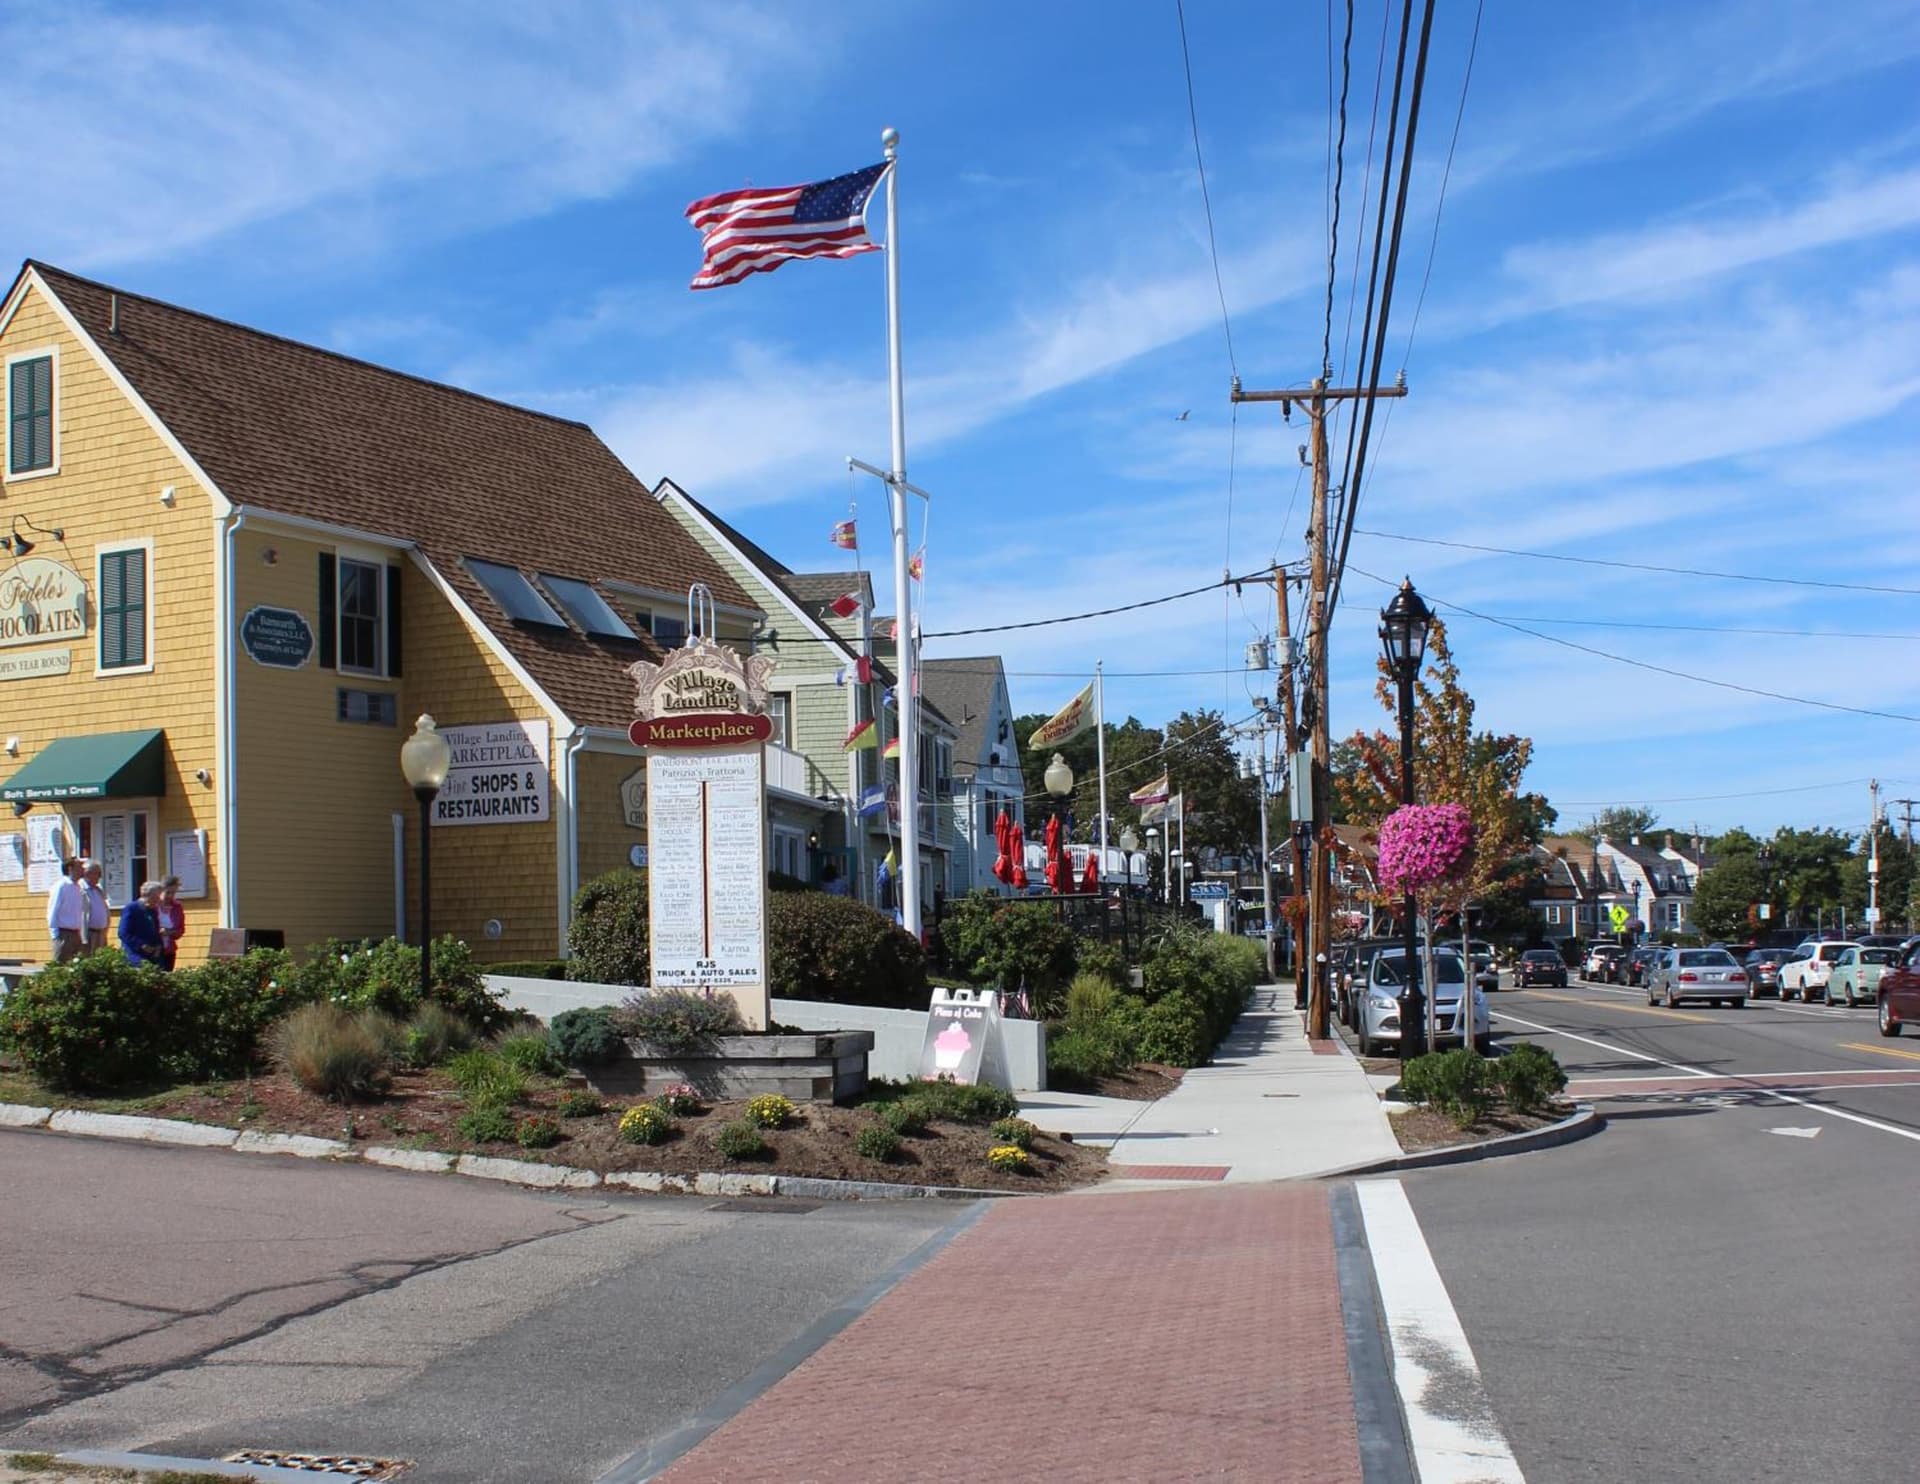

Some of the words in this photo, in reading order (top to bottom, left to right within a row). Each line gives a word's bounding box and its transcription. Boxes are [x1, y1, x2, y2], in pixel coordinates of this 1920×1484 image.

[0, 608, 81, 639] HOCOLATES
[664, 668, 736, 695] Village
[662, 689, 739, 711] Landing
[445, 732, 481, 746] Village
[486, 730, 530, 743] Landing
[649, 721, 755, 741] Marketplace
[449, 744, 539, 764] ARKETPLACE
[4, 789, 24, 799] Soft
[26, 789, 52, 798] Serve
[54, 787, 67, 796] Ice
[69, 786, 99, 795] Cream
[471, 772, 518, 794] SHOPS
[525, 771, 536, 791] &
[438, 795, 540, 819] RESTAURANTS
[728, 968, 757, 976] SALES
